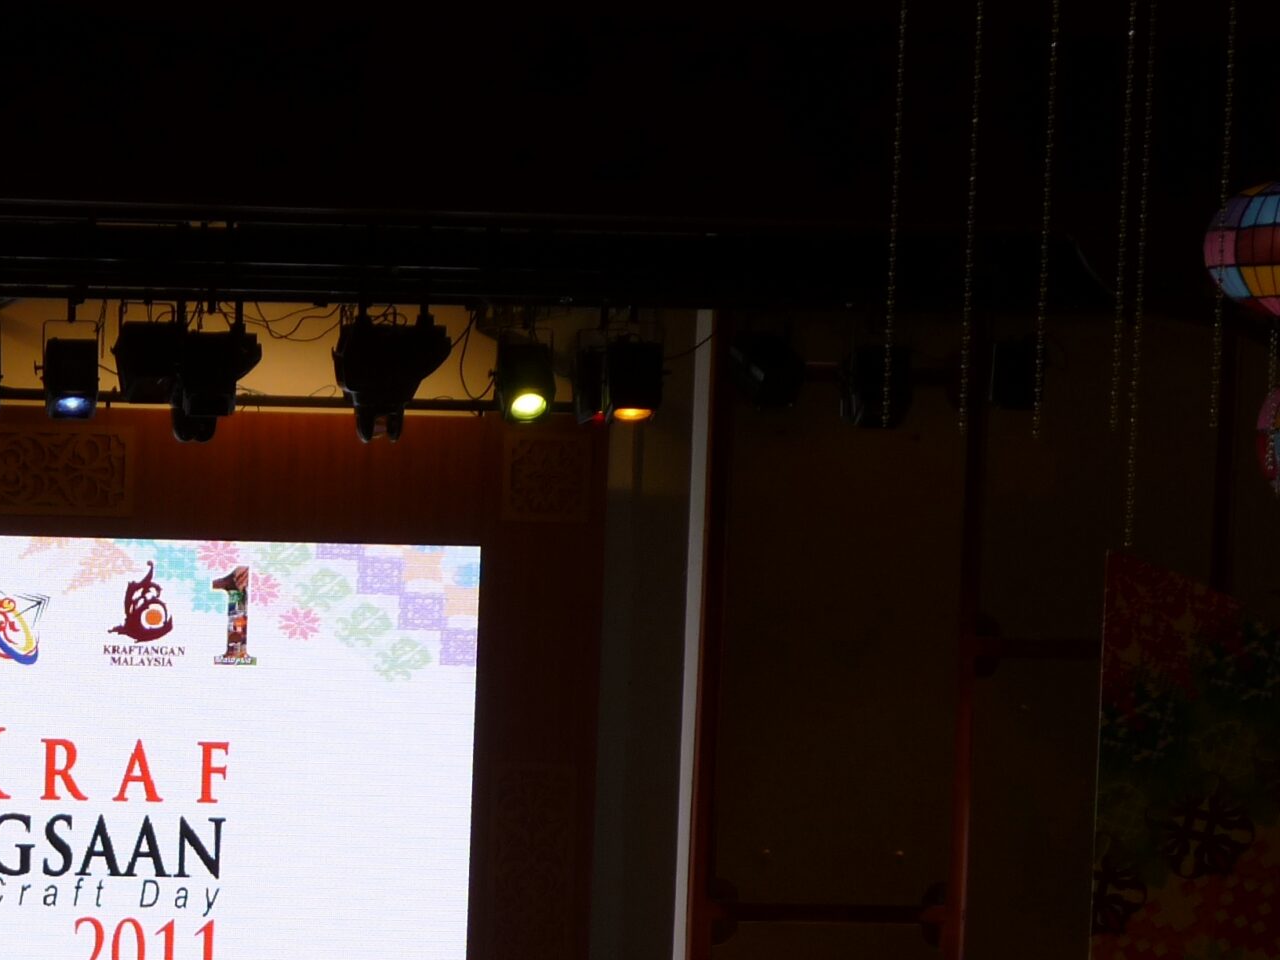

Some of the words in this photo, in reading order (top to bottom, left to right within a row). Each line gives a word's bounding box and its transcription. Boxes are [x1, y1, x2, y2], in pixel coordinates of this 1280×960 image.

[103, 645, 185, 656] KRAFTANGAN
[110, 657, 173, 667] MALAYSIA
[140, 880, 220, 917] Day
